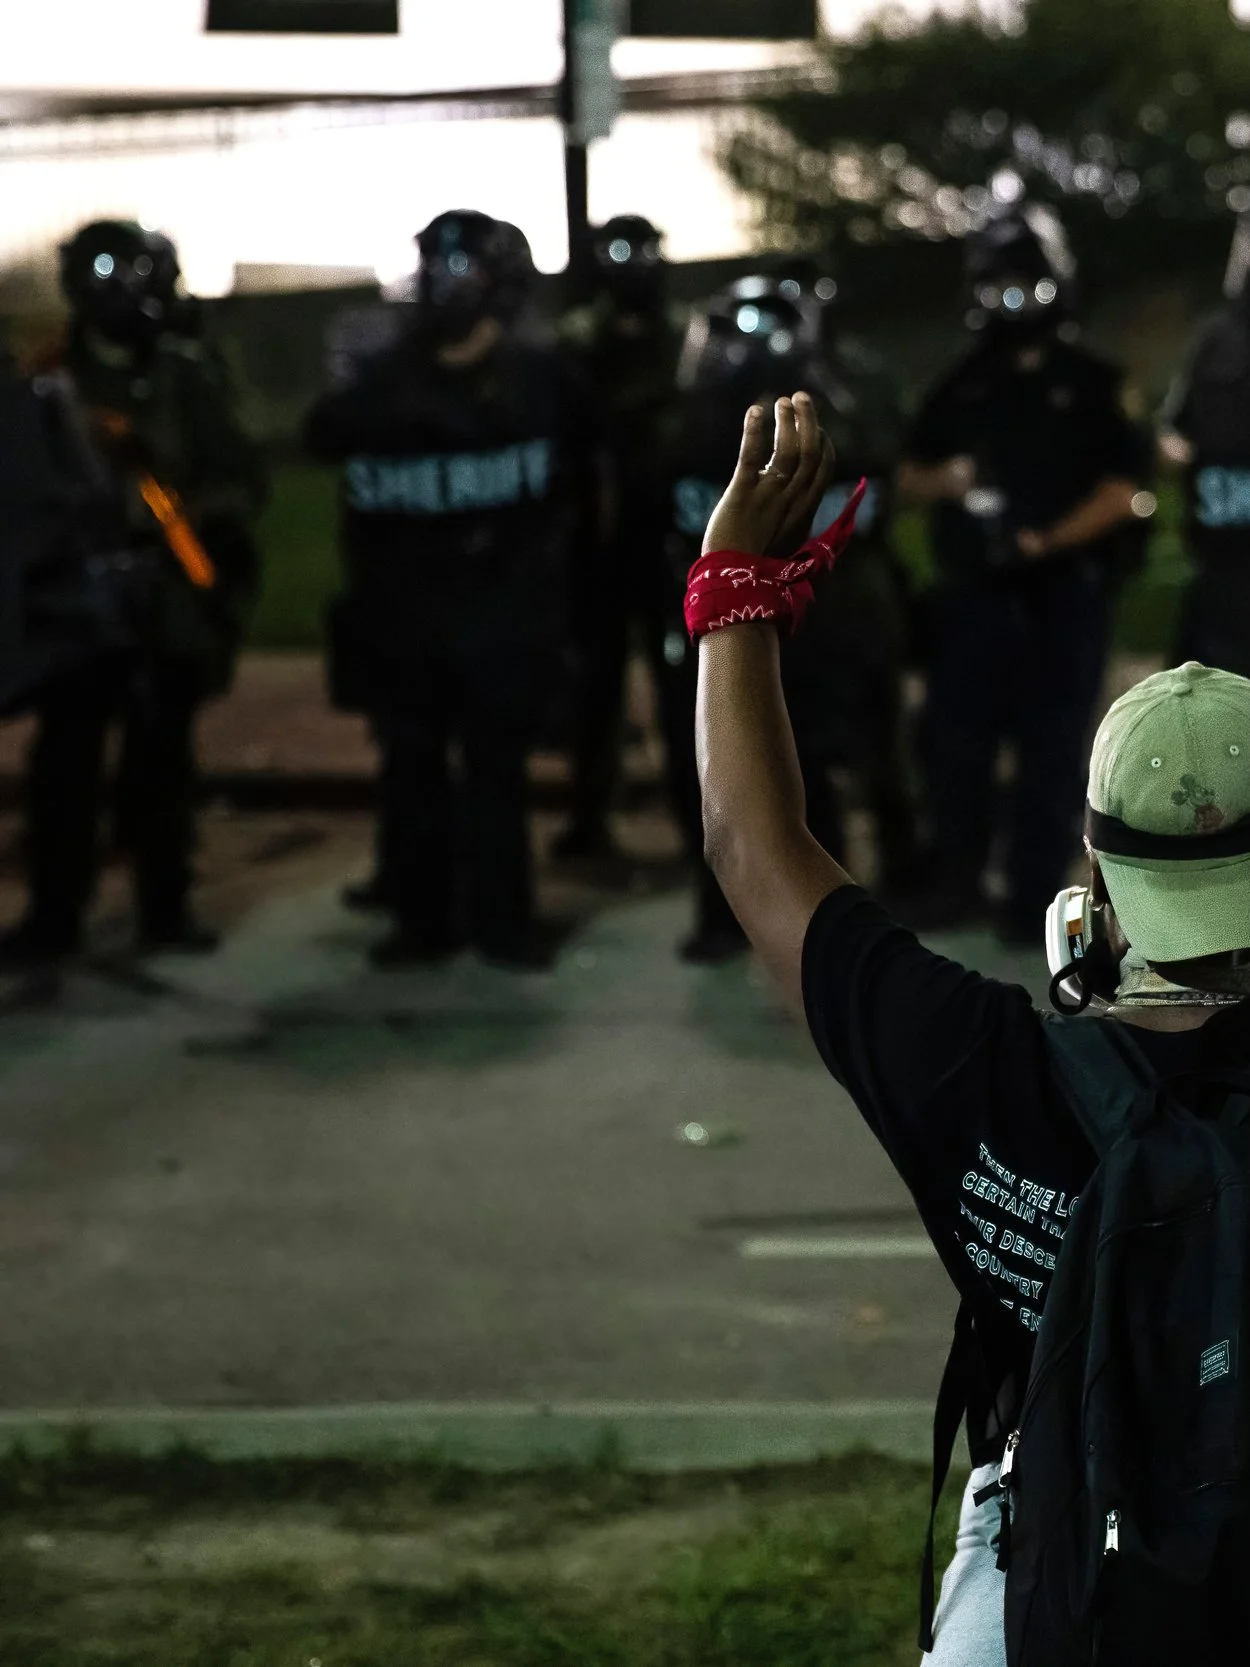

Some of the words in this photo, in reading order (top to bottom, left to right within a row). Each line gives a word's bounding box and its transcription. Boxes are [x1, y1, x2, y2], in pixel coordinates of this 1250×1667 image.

[962, 1171, 1036, 1224] CERTAIN
[979, 1142, 1016, 1188] THEN
[1020, 1179, 1056, 1212] THE
[965, 1242, 1043, 1300] COUNTRY
[998, 1229, 1056, 1271] DESCE
